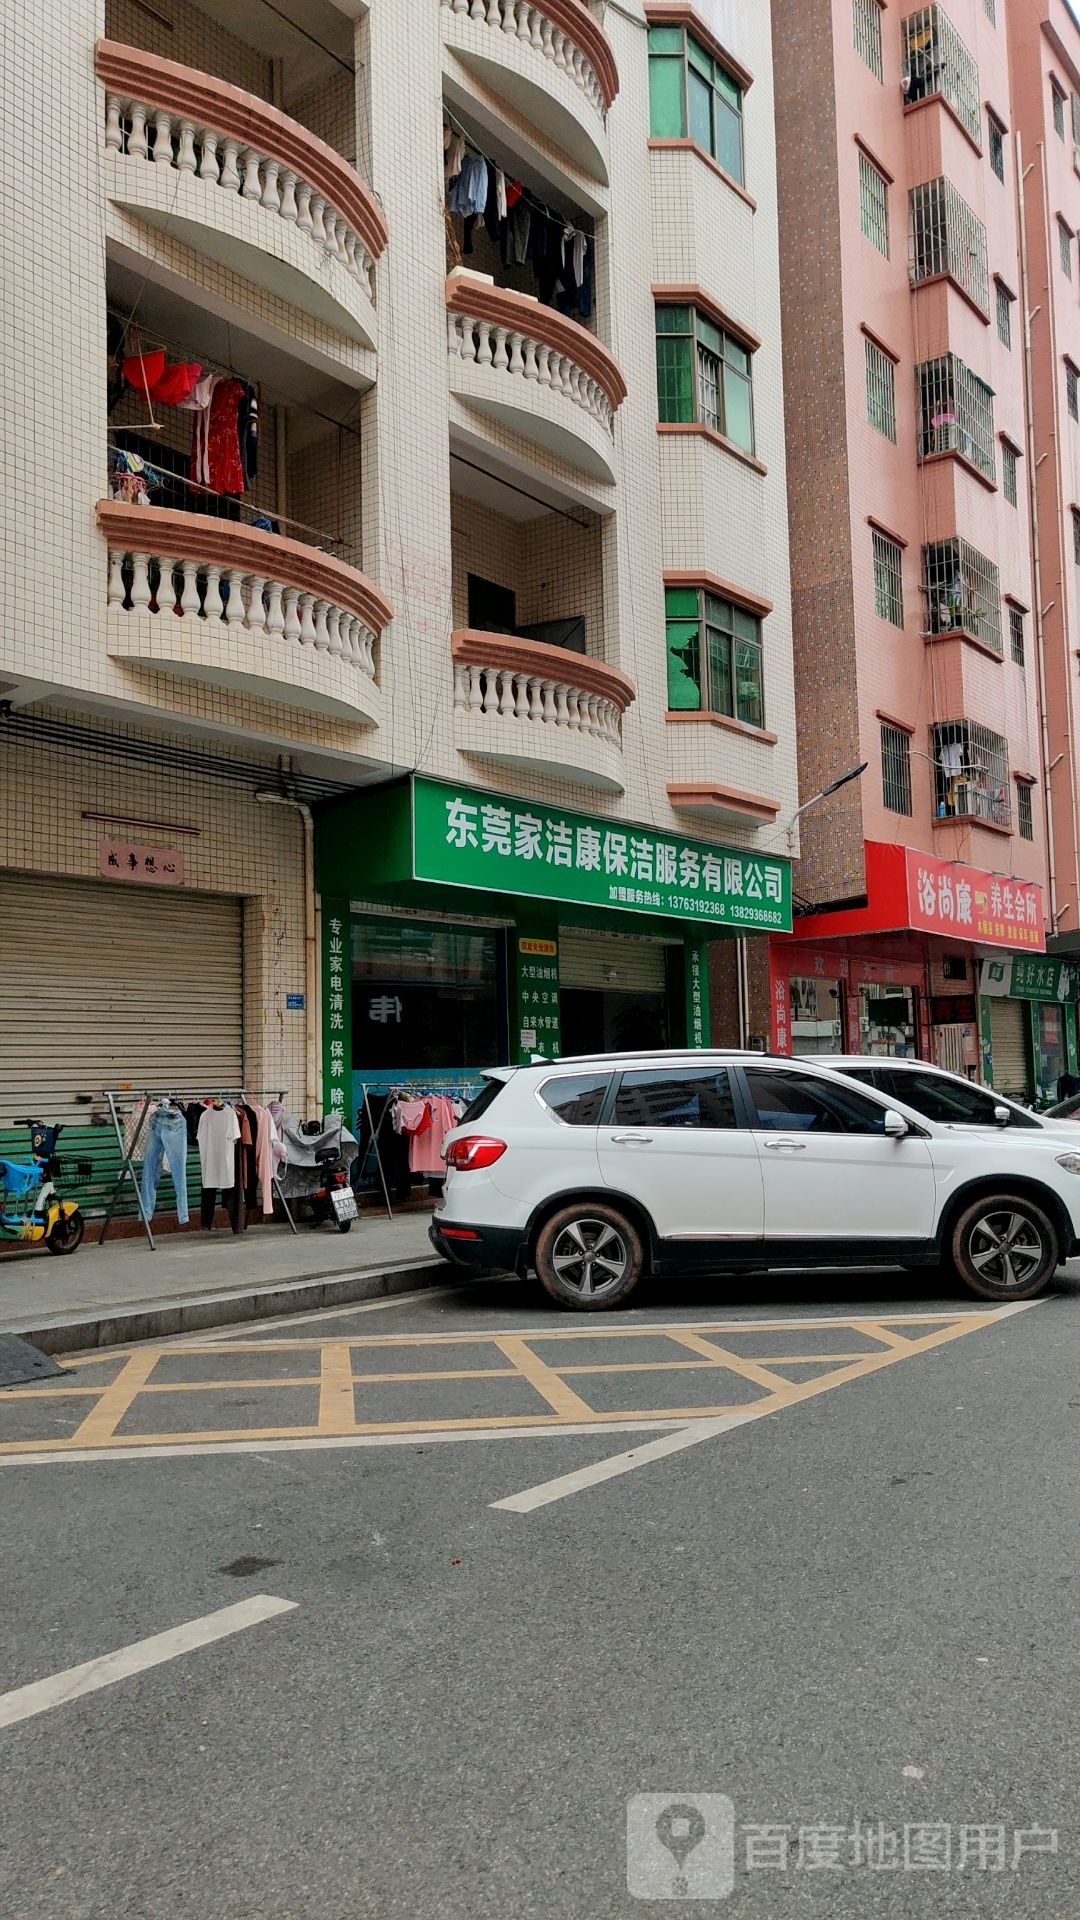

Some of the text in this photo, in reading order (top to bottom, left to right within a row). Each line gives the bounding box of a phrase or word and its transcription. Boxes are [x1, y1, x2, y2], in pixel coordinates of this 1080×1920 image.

[446, 797, 782, 903] 东莞家洁康保洁服务有限公司
[668, 895, 725, 916] 13763192368
[730, 905, 782, 924] 13829368682
[918, 867, 1037, 925] 浴尚康 养生会所
[329, 918, 343, 1029] 专业家电清洗
[521, 965, 557, 980] 大型油烟机
[522, 990, 558, 1004] 中央空调
[692, 951, 702, 1049] 承接大型油烟机
[523, 1016, 559, 1029] 自来水管道
[775, 980, 788, 1055] 浴尚康
[330, 1040, 344, 1077] 保养
[523, 1041, 559, 1054] 衣机
